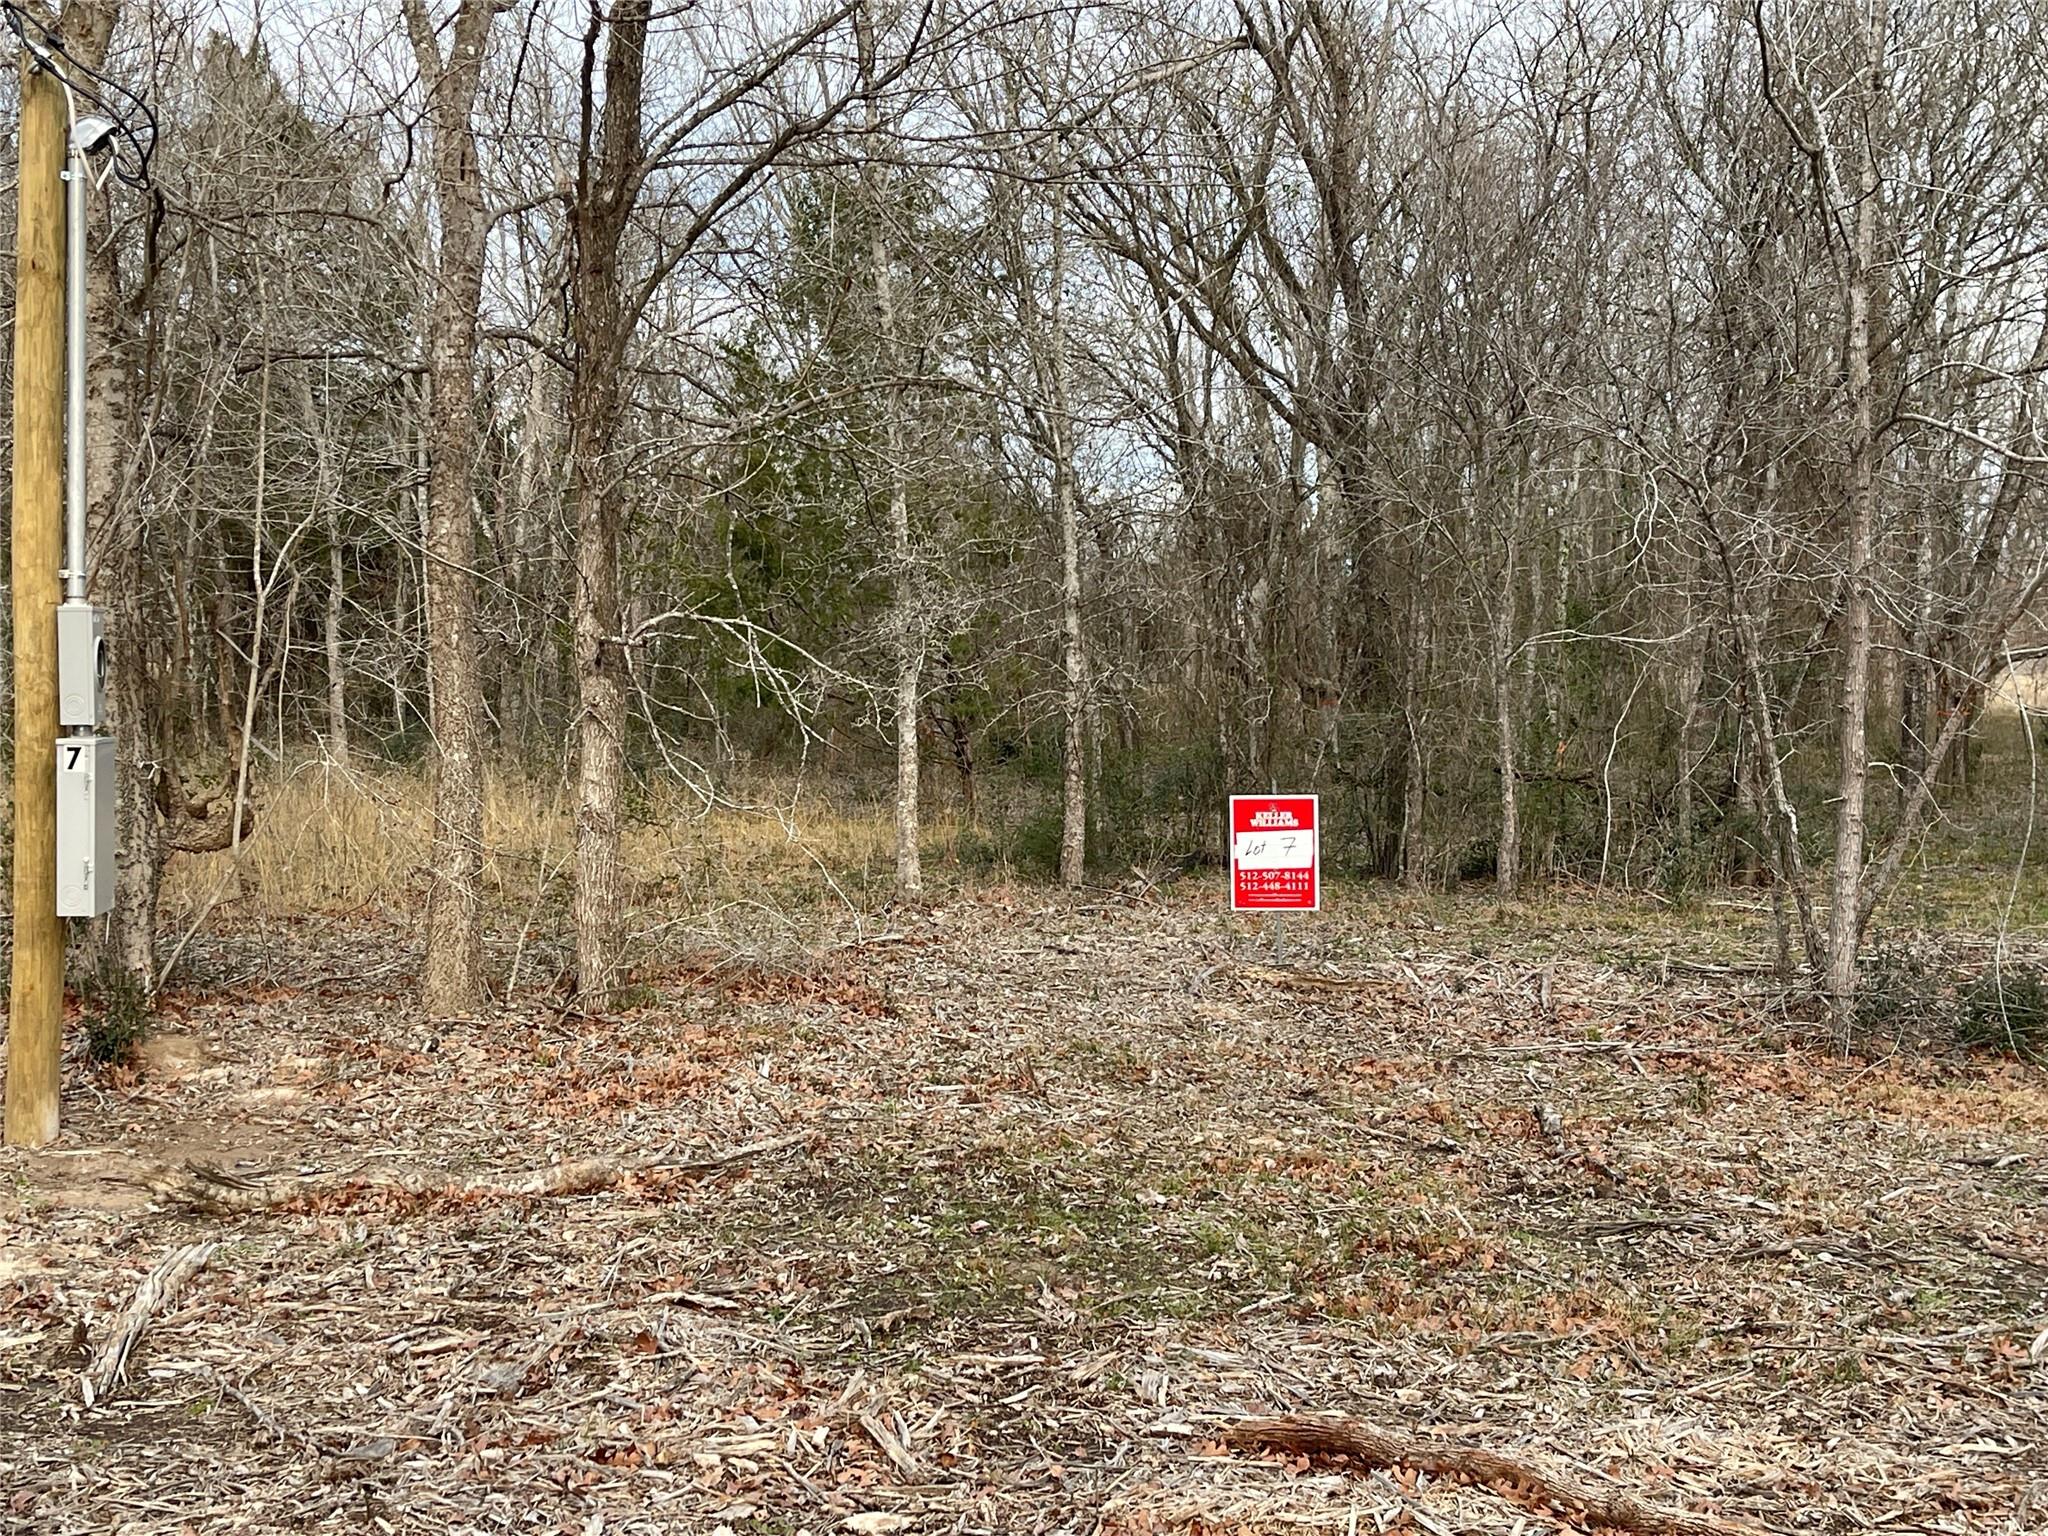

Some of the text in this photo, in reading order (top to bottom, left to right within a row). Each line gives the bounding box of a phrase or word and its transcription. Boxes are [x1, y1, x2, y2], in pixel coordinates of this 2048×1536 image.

[67, 747, 82, 770] 7
[1245, 837, 1296, 856] Lot 7
[1240, 871, 1309, 880] 512-507-8144
[1240, 881, 1309, 891] 512-448-4111
